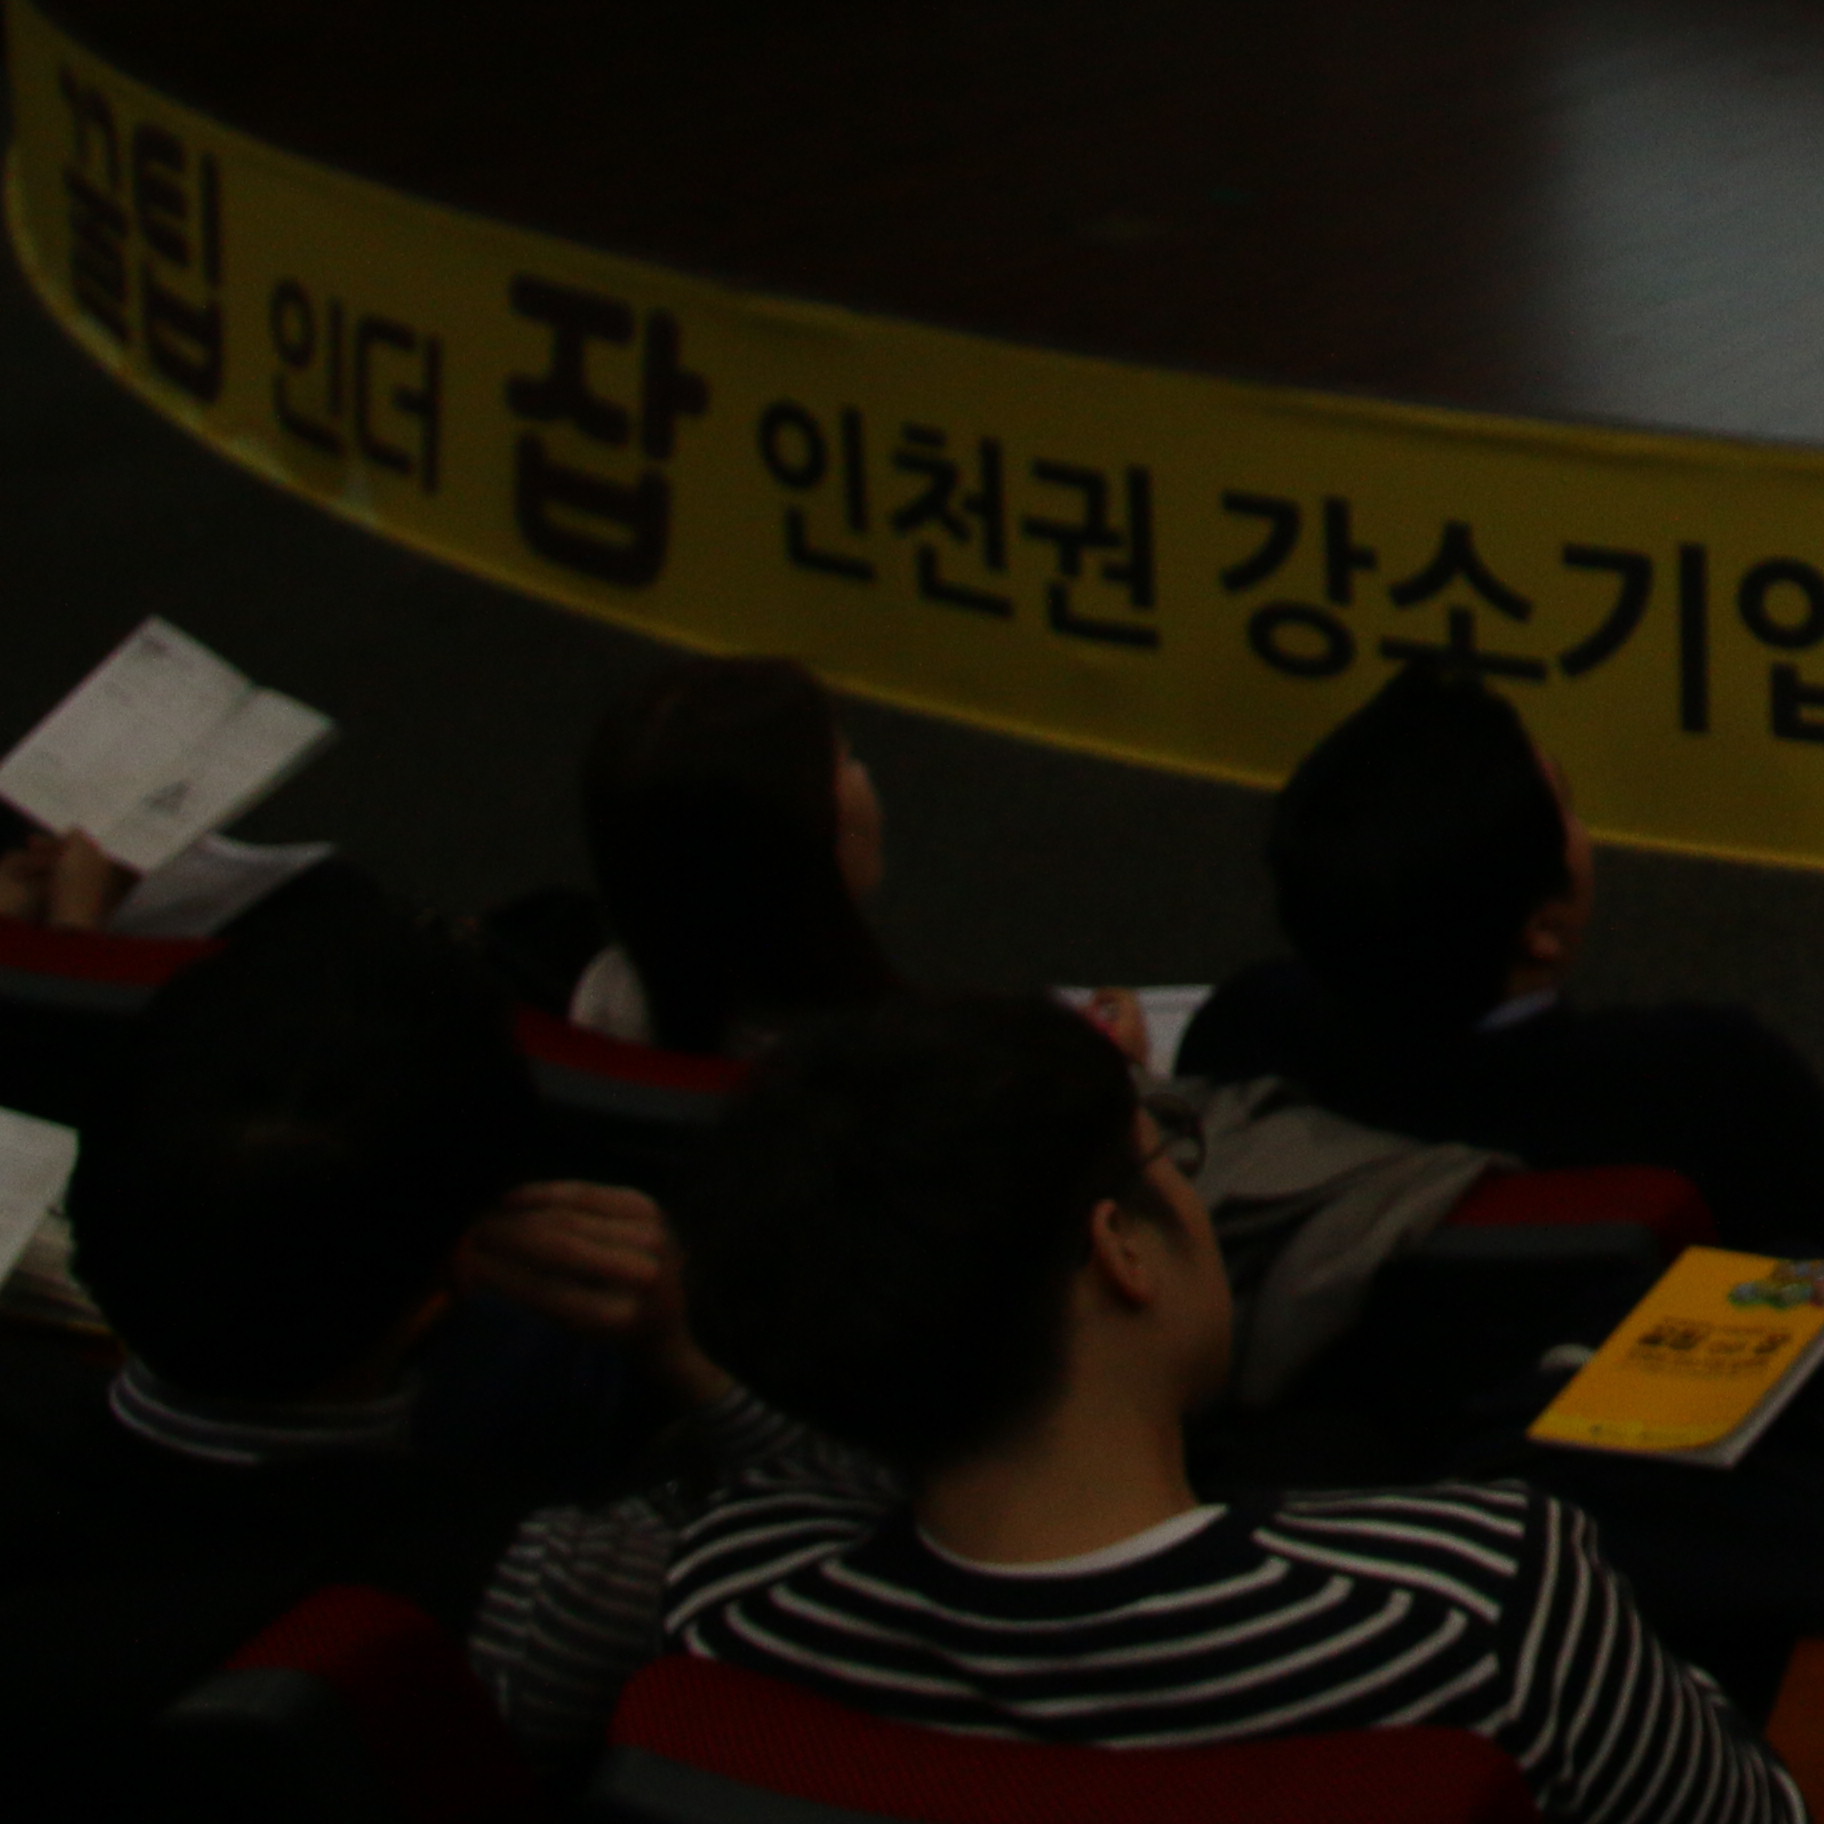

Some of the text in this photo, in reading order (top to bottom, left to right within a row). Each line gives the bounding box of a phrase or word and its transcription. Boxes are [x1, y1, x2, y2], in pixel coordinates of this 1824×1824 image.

[270, 274, 443, 498] 인더
[507, 274, 708, 588] 잡
[758, 401, 1160, 651] 인천권
